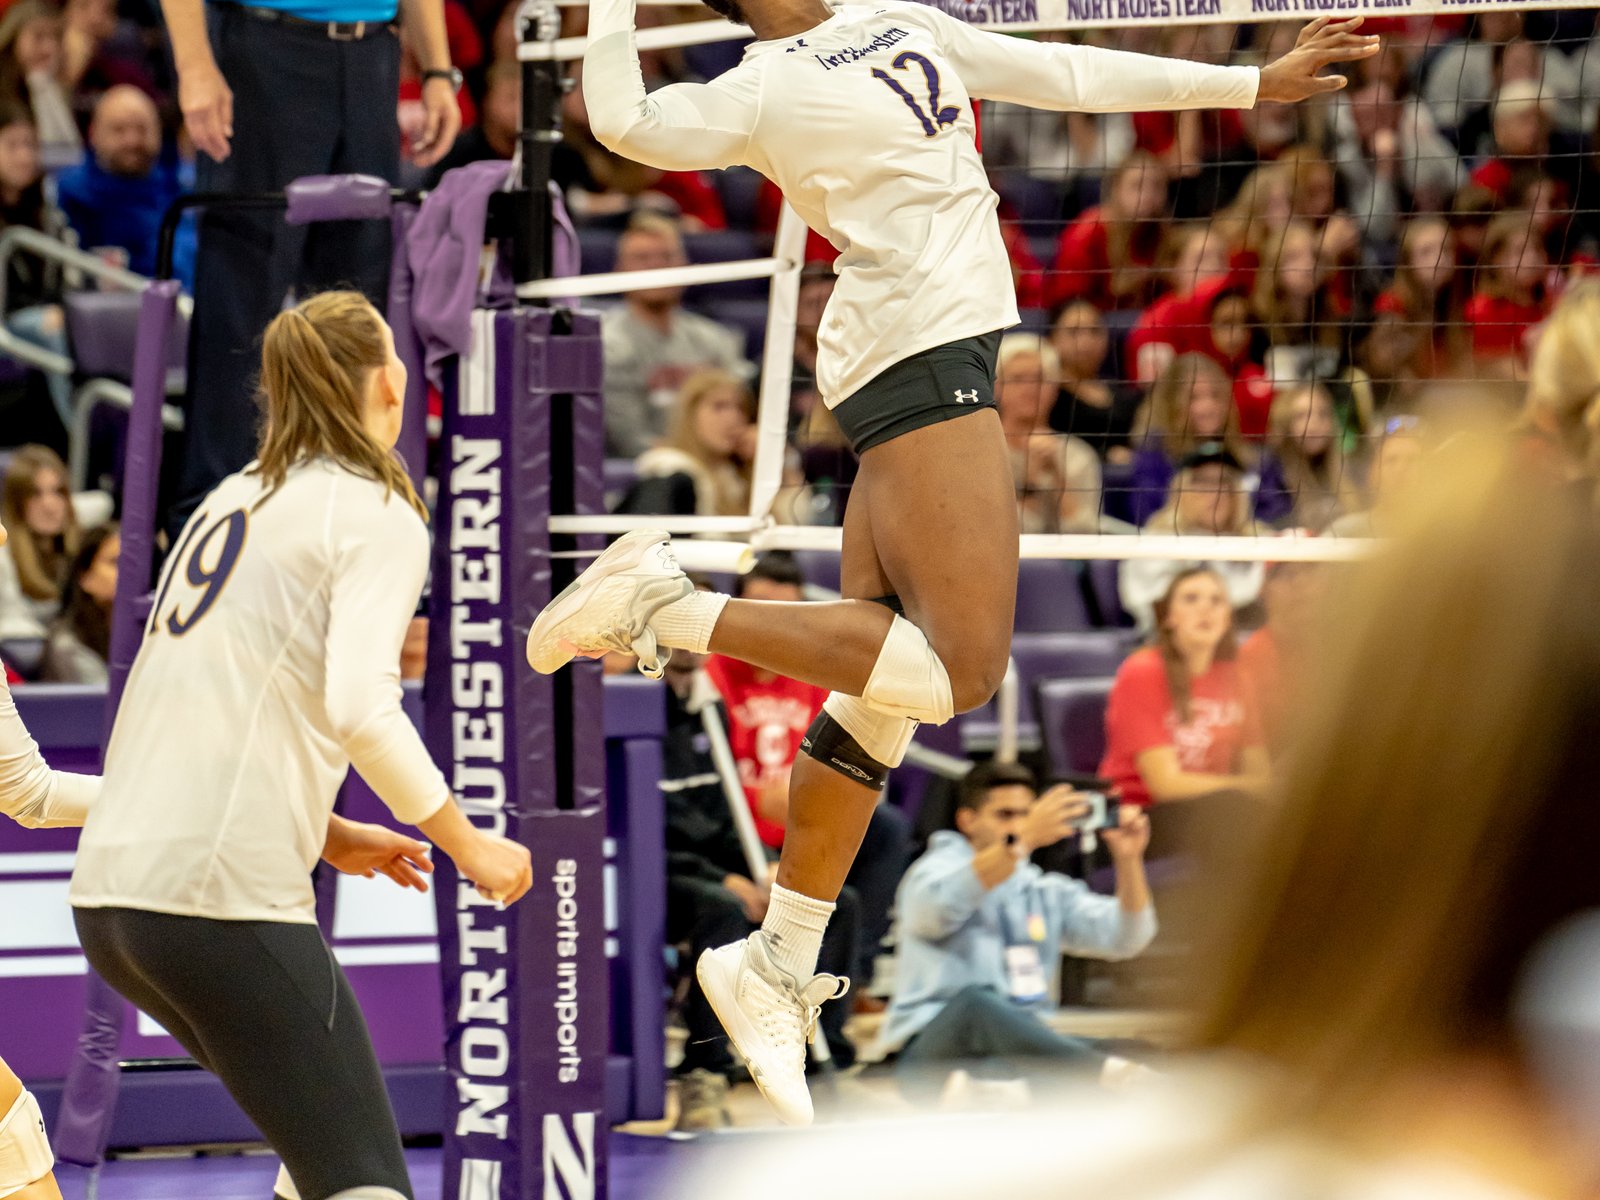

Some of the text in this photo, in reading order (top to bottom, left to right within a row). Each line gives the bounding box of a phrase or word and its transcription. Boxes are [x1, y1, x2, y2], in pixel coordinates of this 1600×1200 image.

[870, 50, 961, 138] 12
[148, 507, 249, 638] 19
[551, 858, 582, 1083] sports imports
